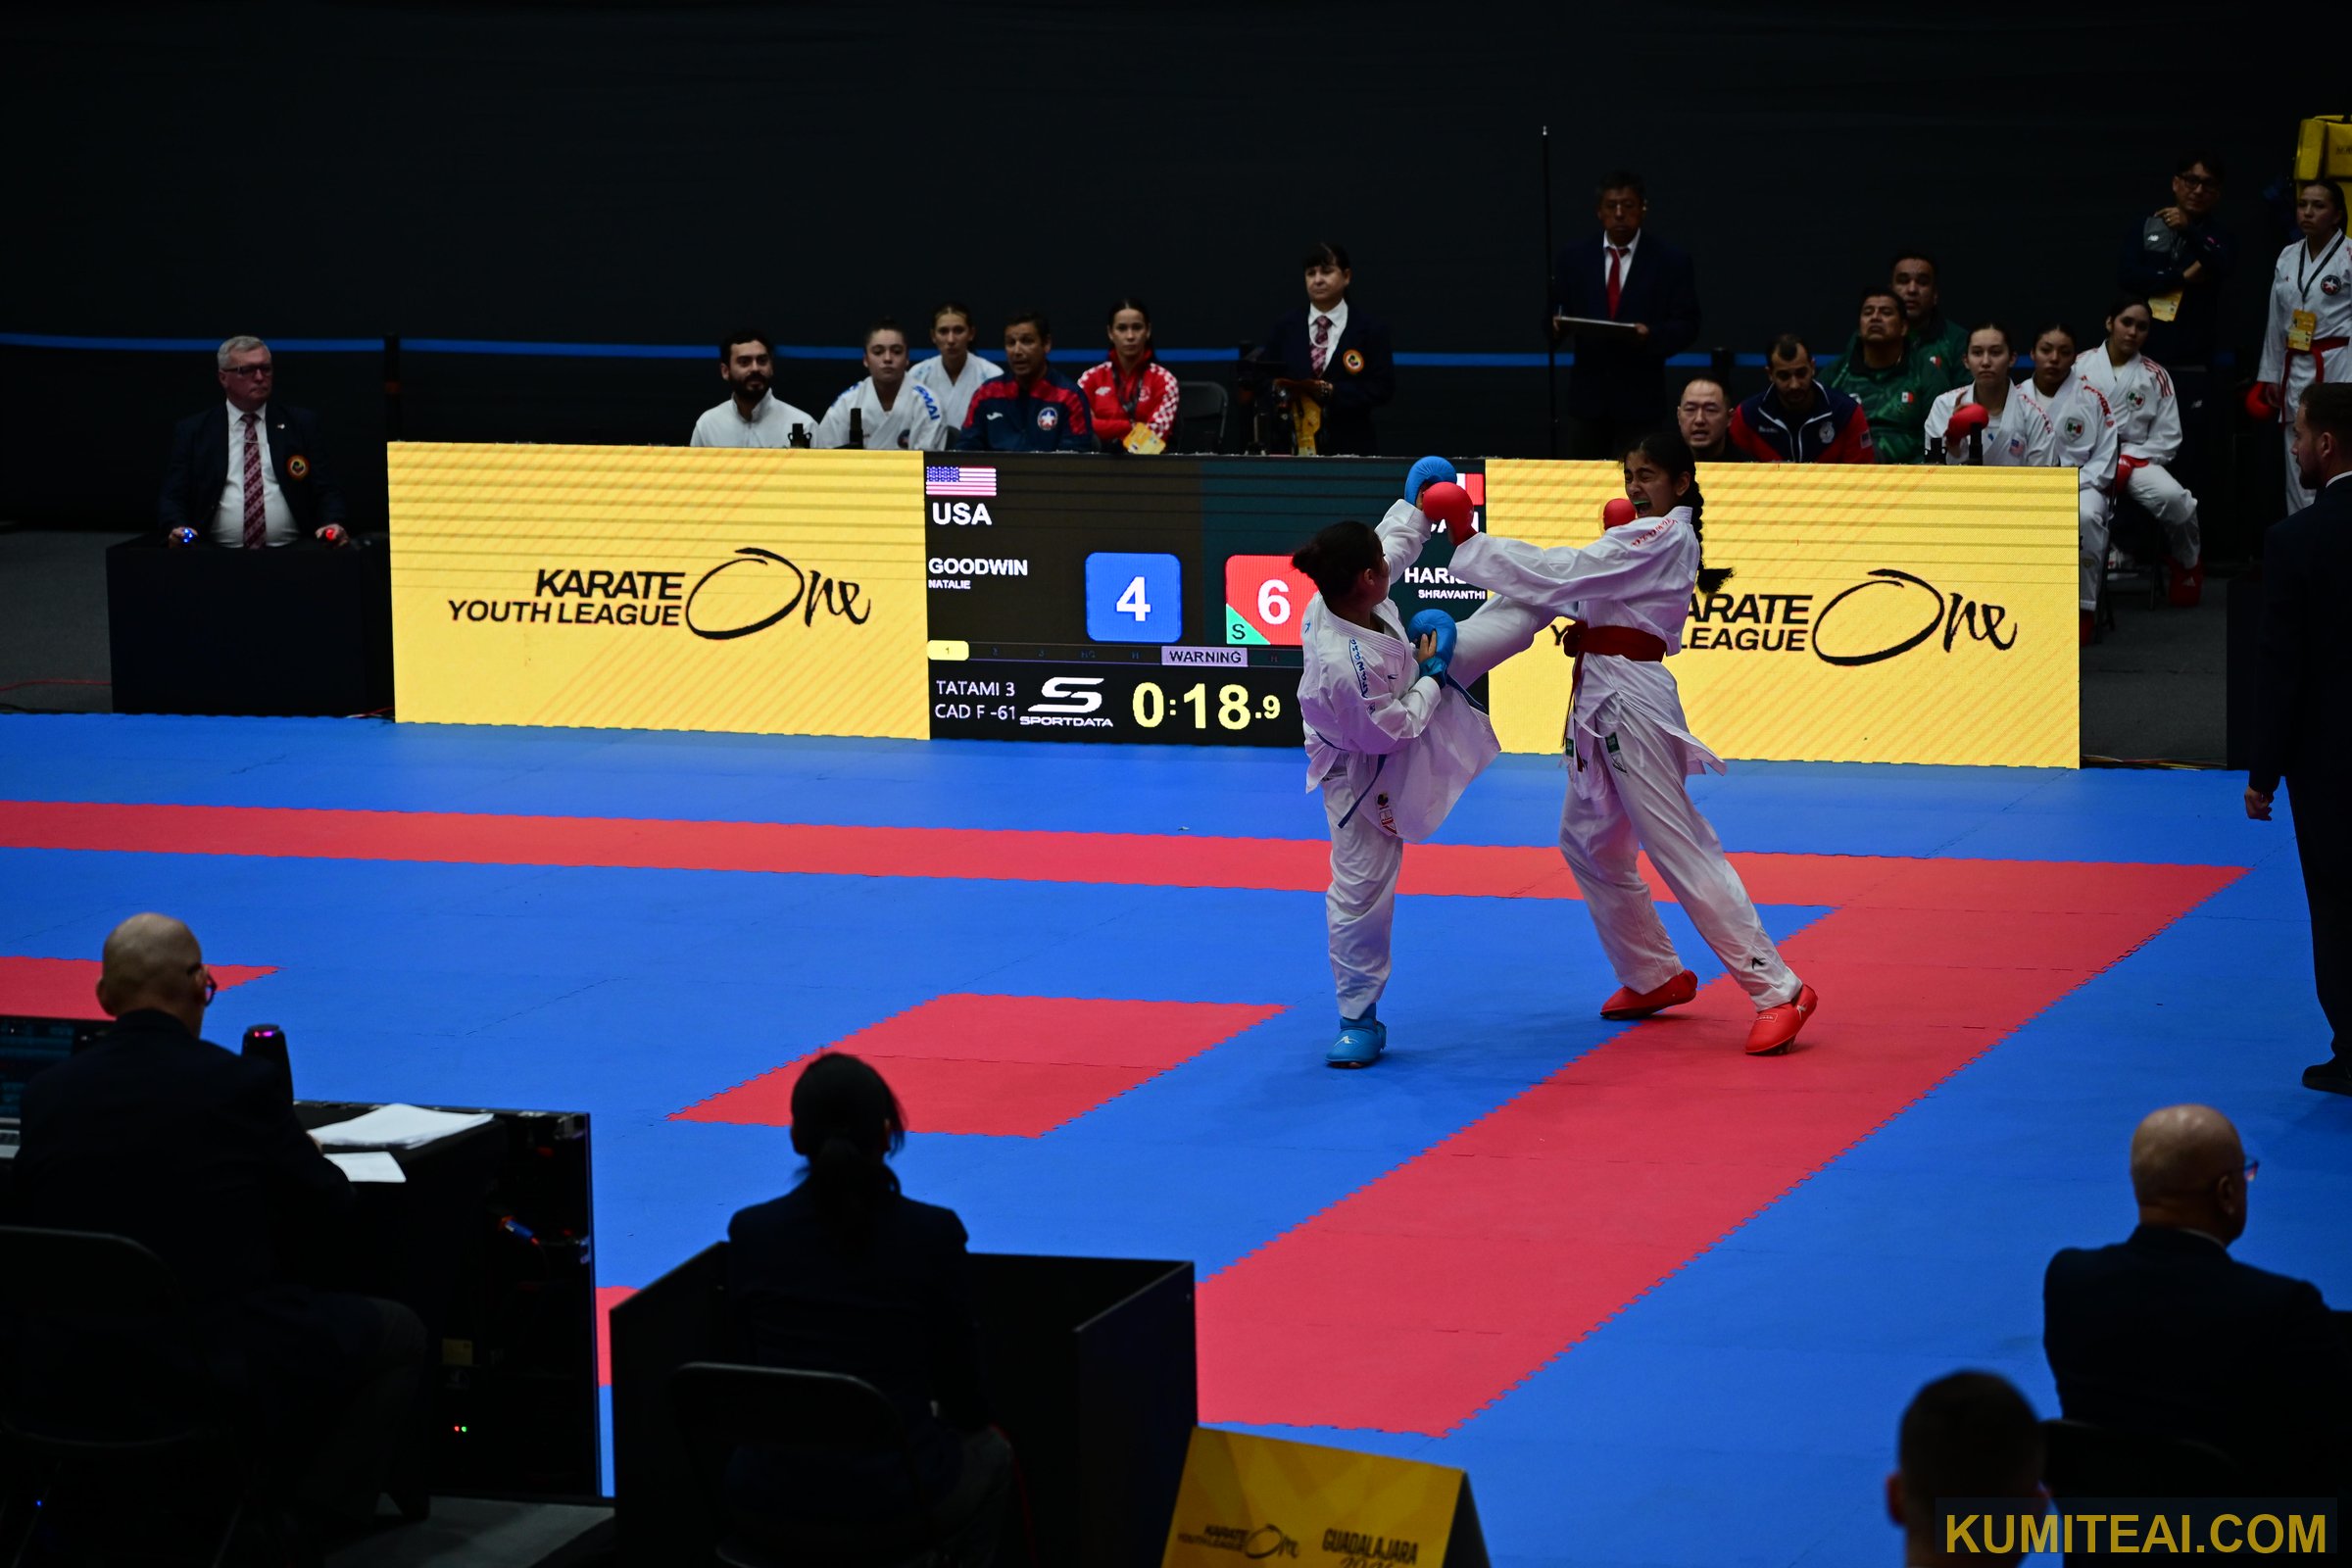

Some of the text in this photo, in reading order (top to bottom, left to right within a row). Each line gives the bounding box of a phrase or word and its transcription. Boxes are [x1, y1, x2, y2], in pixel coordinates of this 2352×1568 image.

[932, 502, 992, 525] USA
[928, 558, 1028, 576] GOODWIN
[535, 547, 871, 640] KARATE One
[928, 579, 971, 590] NATALIE
[1418, 589, 1486, 600] SHRAVANTHI
[1116, 576, 1292, 625] 4 6
[448, 600, 680, 626] YOUTH LEAGUE
[1689, 568, 2018, 666] ARATE One
[1232, 623, 1247, 640] S
[1682, 628, 1808, 652] EAGUE
[1169, 651, 1242, 663] WARNING
[936, 680, 1015, 697] TATAMI 3
[934, 704, 1015, 720] CAD F -61
[1132, 681, 1281, 730] 0:18.9
[1020, 716, 1113, 728] SPORTDATA
[1322, 1528, 1418, 1565] GUADALAJARA
